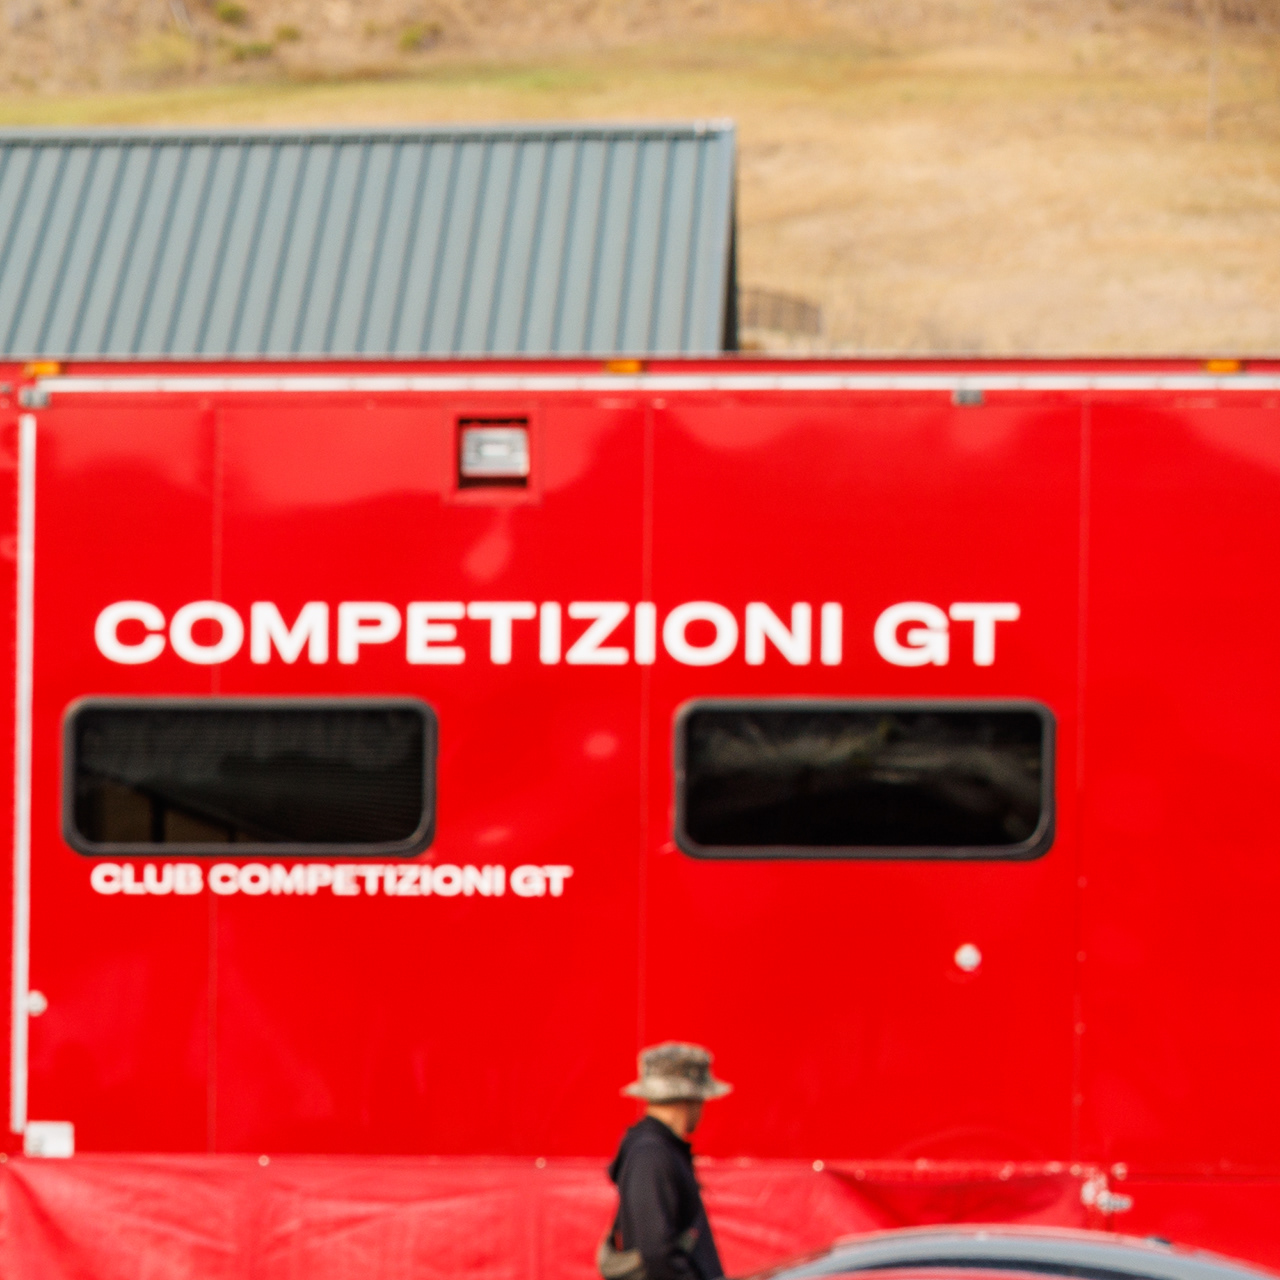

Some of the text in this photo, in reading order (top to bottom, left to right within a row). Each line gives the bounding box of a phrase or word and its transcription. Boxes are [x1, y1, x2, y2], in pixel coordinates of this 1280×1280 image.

[93, 600, 1022, 667] COMPETIZIONI GT
[90, 862, 574, 897] CLUB COMPETIZIONI GT
